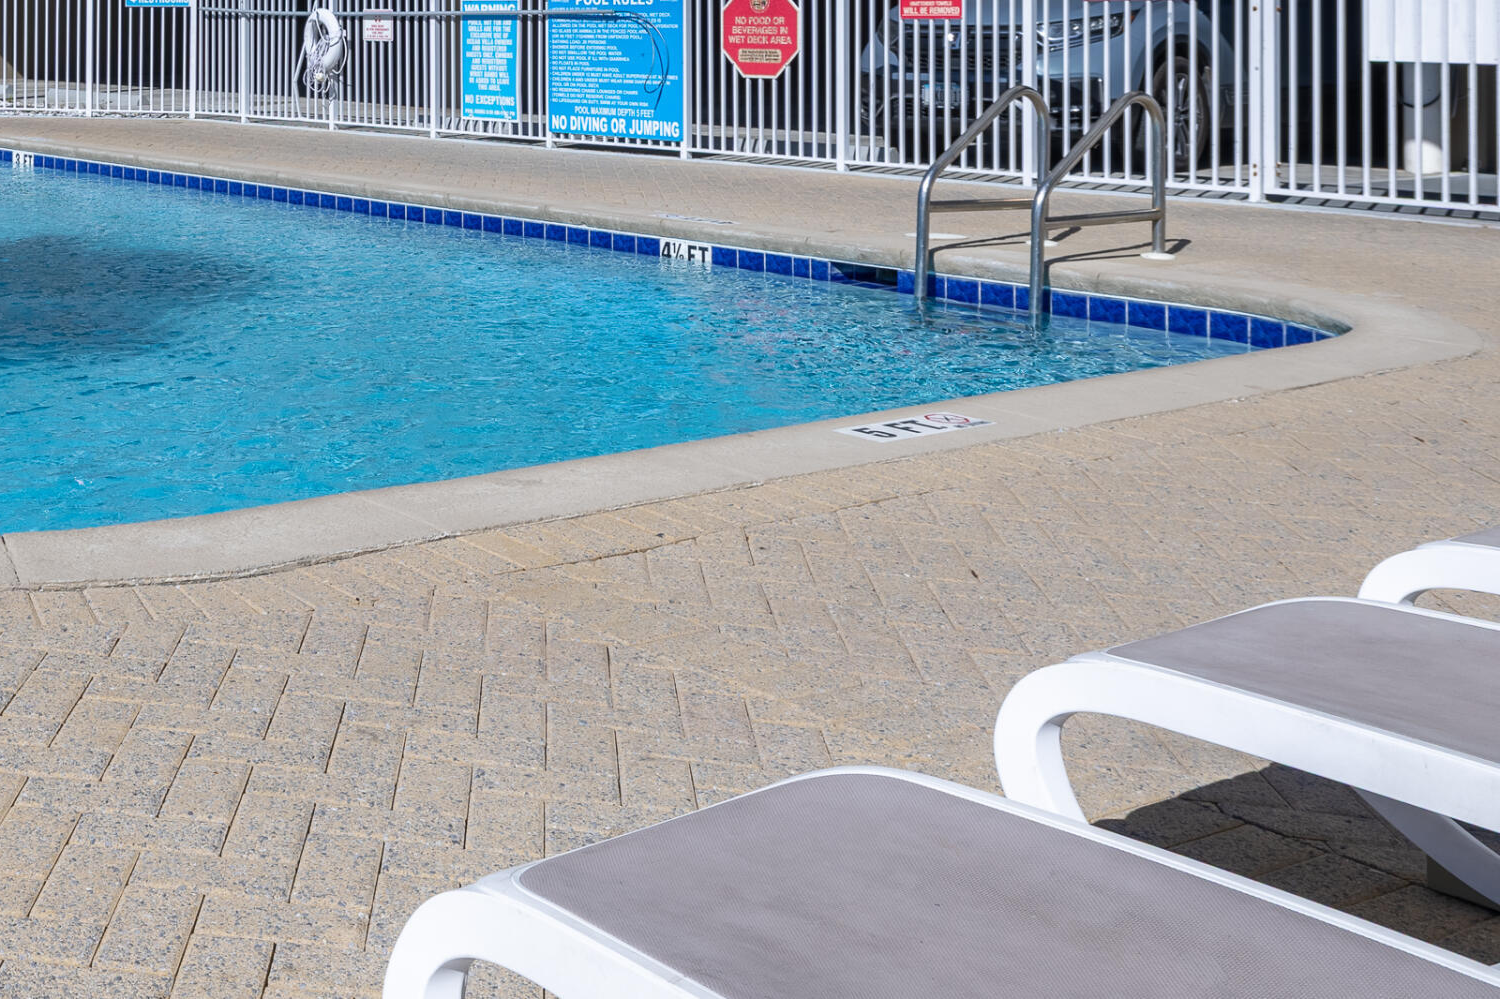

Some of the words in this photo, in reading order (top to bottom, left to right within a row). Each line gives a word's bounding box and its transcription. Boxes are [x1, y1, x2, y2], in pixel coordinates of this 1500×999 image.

[929, 6, 960, 14] REMOVED
[735, 16, 746, 24] NO
[748, 16, 771, 24] FOOD
[772, 16, 785, 24] OR
[732, 26, 778, 34] BEVERAGES
[780, 26, 788, 34] IN
[728, 36, 745, 44] WET
[747, 36, 768, 44] DECK
[770, 36, 792, 44] AREA
[465, 94, 474, 104] NO
[475, 95, 515, 106] EXCEPTIONS
[574, 106, 589, 114] POOL
[591, 107, 616, 116] MAXIMUM
[618, 108, 635, 117] DEPTH
[636, 109, 640, 117] 5
[640, 109, 654, 118] FEET
[551, 115, 567, 130] NO
[570, 116, 608, 132] DIVING
[611, 118, 626, 134] OR
[629, 120, 680, 138] JUMPING
[16, 153, 20, 165] 3
[24, 154, 32, 166] FT
[687, 245, 708, 263] FT
[852, 427, 897, 438] 5
[883, 420, 948, 434] FT
